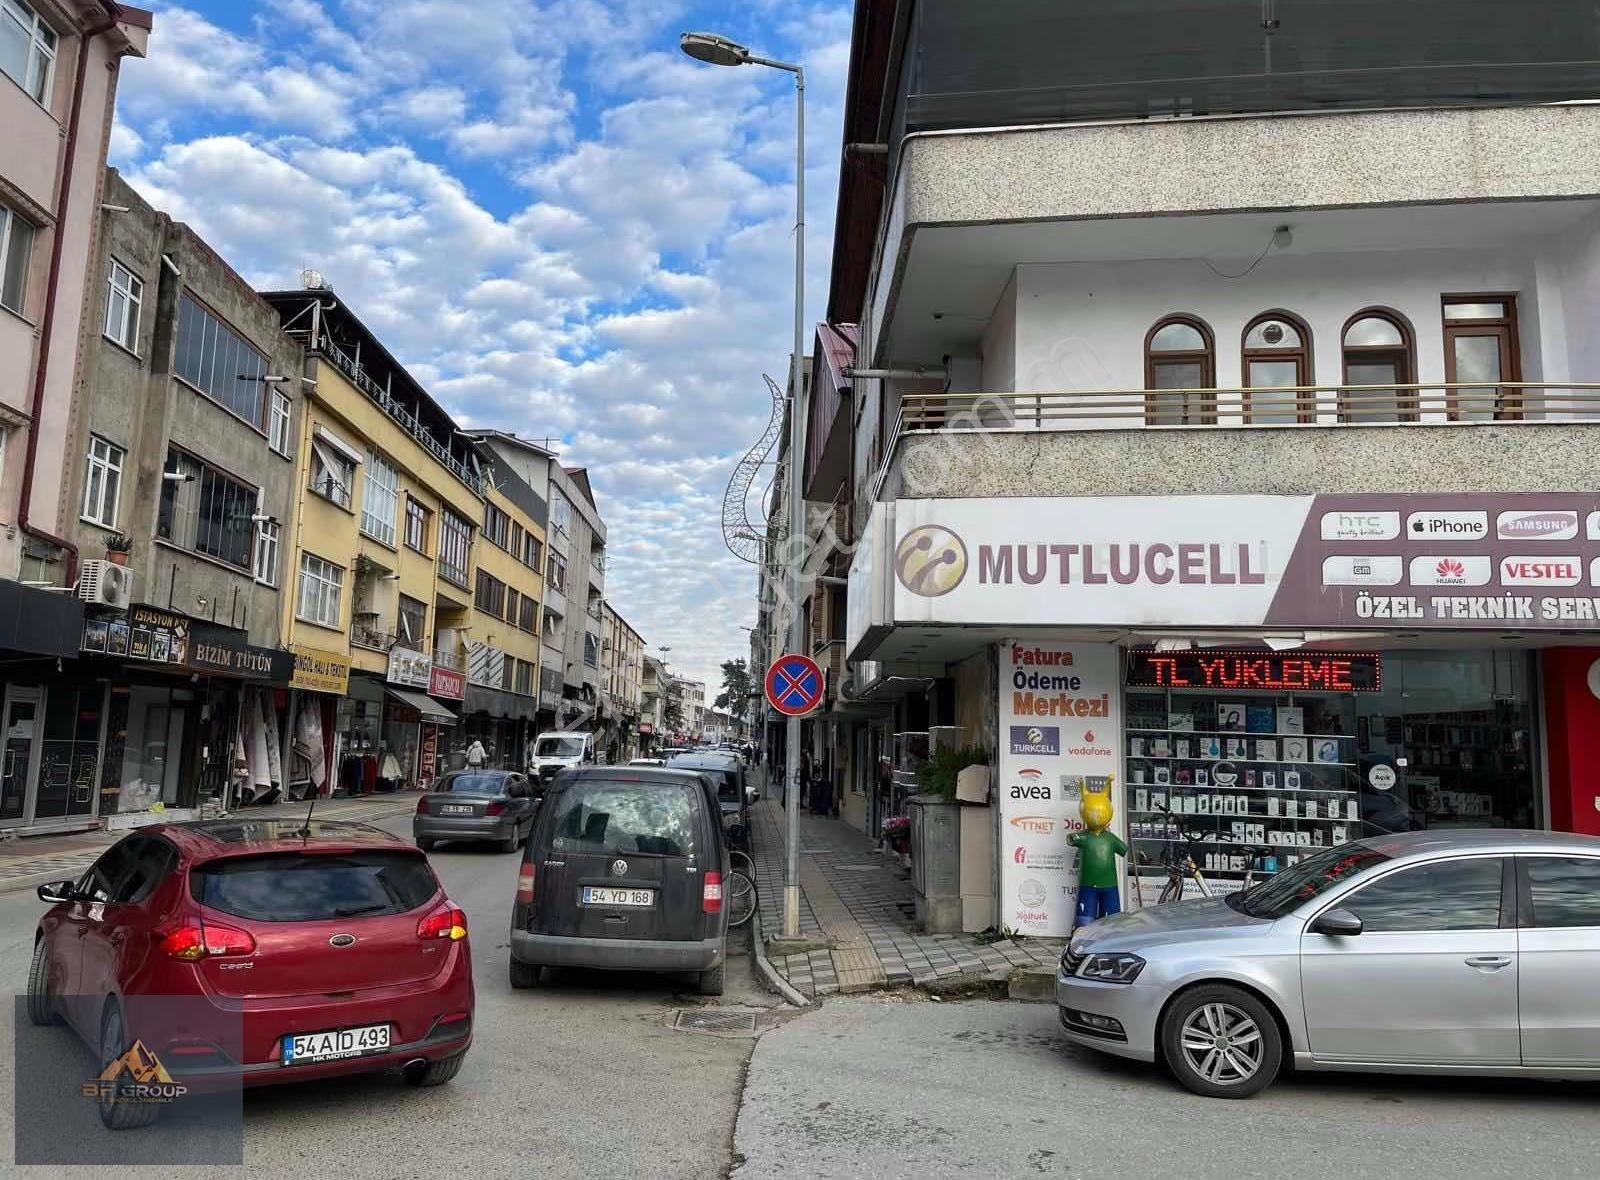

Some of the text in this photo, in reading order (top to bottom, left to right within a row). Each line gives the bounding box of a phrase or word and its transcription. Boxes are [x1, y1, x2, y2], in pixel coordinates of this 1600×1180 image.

[1339, 513, 1380, 527] htc
[1428, 519, 1483, 536] iPhone
[1508, 519, 1569, 531] SAMSUNG
[978, 543, 1265, 585] MUTLUCELL
[1504, 563, 1577, 579] VESTEL
[1355, 591, 1424, 619] ÖZEL
[1431, 591, 1534, 620] TEKNİK
[196, 643, 272, 672] BİZİM TÜTÜN
[1012, 646, 1073, 666] Fatura
[1013, 665, 1081, 691] Ödeme
[1147, 658, 1189, 684] TL
[1013, 692, 1109, 718] Merkezi
[1014, 743, 1057, 754] TURKCELL
[1068, 746, 1112, 756] vodafone
[1010, 785, 1051, 800] avea
[1022, 821, 1056, 831] TTNET
[592, 890, 605, 902] 54
[610, 890, 627, 902] YD
[632, 891, 649, 903] 168
[294, 1037, 316, 1056] 54
[359, 1027, 388, 1048] 493
[312, 1054, 325, 1062] HK
[326, 1050, 362, 1061] MOTORS
